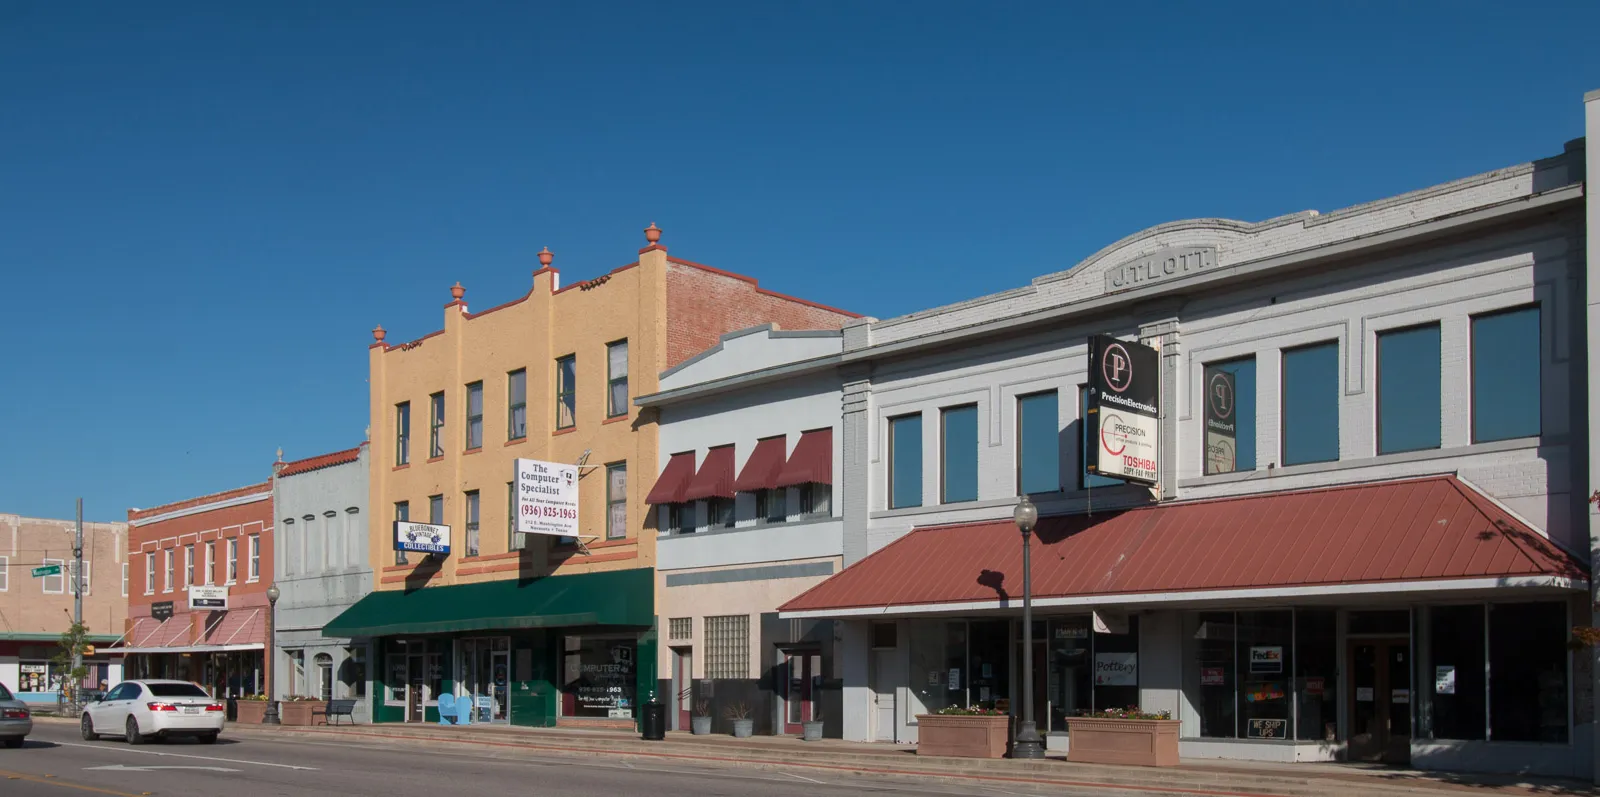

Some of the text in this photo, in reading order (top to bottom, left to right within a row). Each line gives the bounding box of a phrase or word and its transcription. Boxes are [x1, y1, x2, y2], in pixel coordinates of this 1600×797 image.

[1111, 353, 1126, 382] P
[1102, 391, 1158, 414] PrecisionElectronics
[1115, 424, 1146, 437] PRECISION
[533, 464, 548, 473] The
[1122, 454, 1156, 471] TOSHIBA
[521, 471, 560, 483] Computer
[521, 483, 560, 496] Specialist
[521, 504, 576, 519] (936) 825-1963
[409, 524, 439, 535] BLUEBONNET
[404, 542, 444, 552] COLLECTIBLES
[1252, 650, 1279, 660] FedEx
[1096, 661, 1135, 674] Pottery
[1254, 720, 1262, 728] WE
[1259, 729, 1274, 737] UPS
